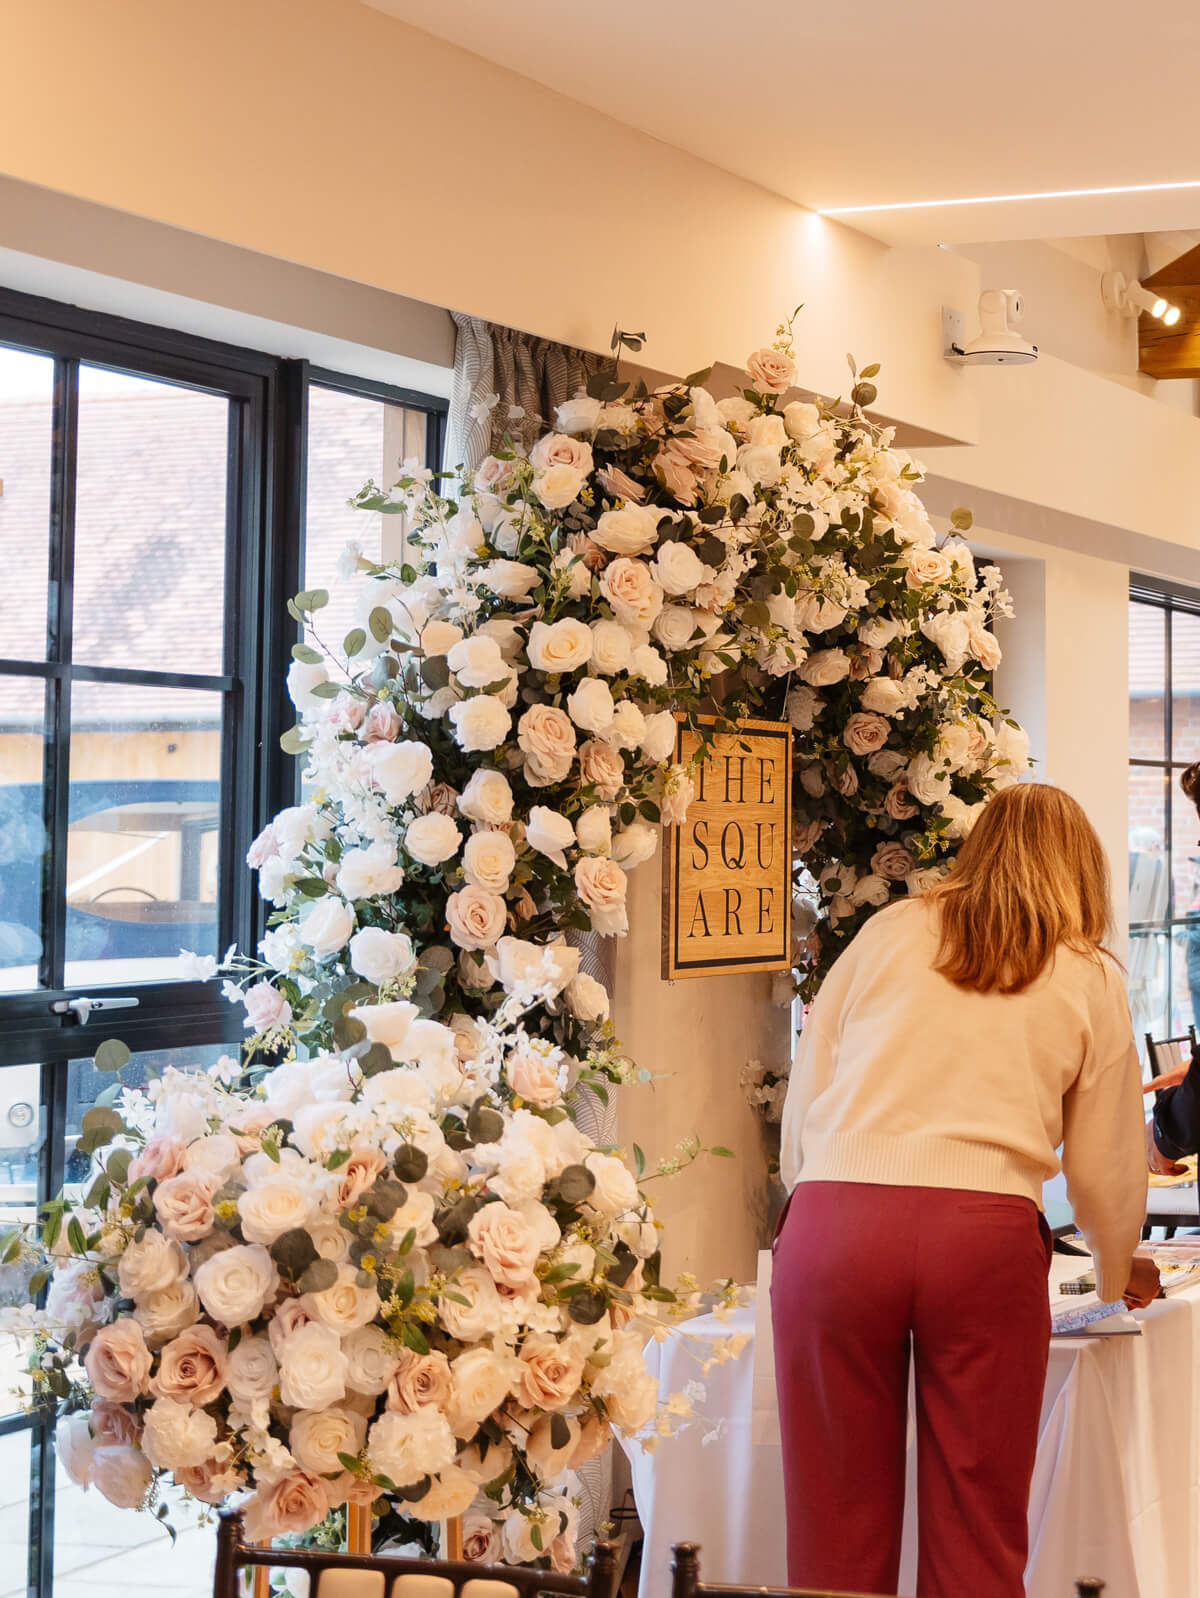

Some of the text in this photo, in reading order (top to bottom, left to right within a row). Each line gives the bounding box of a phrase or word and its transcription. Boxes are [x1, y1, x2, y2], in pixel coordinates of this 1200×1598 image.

[694, 755, 776, 804] THE
[691, 820, 777, 870] SQU
[686, 887, 774, 938] ARE
